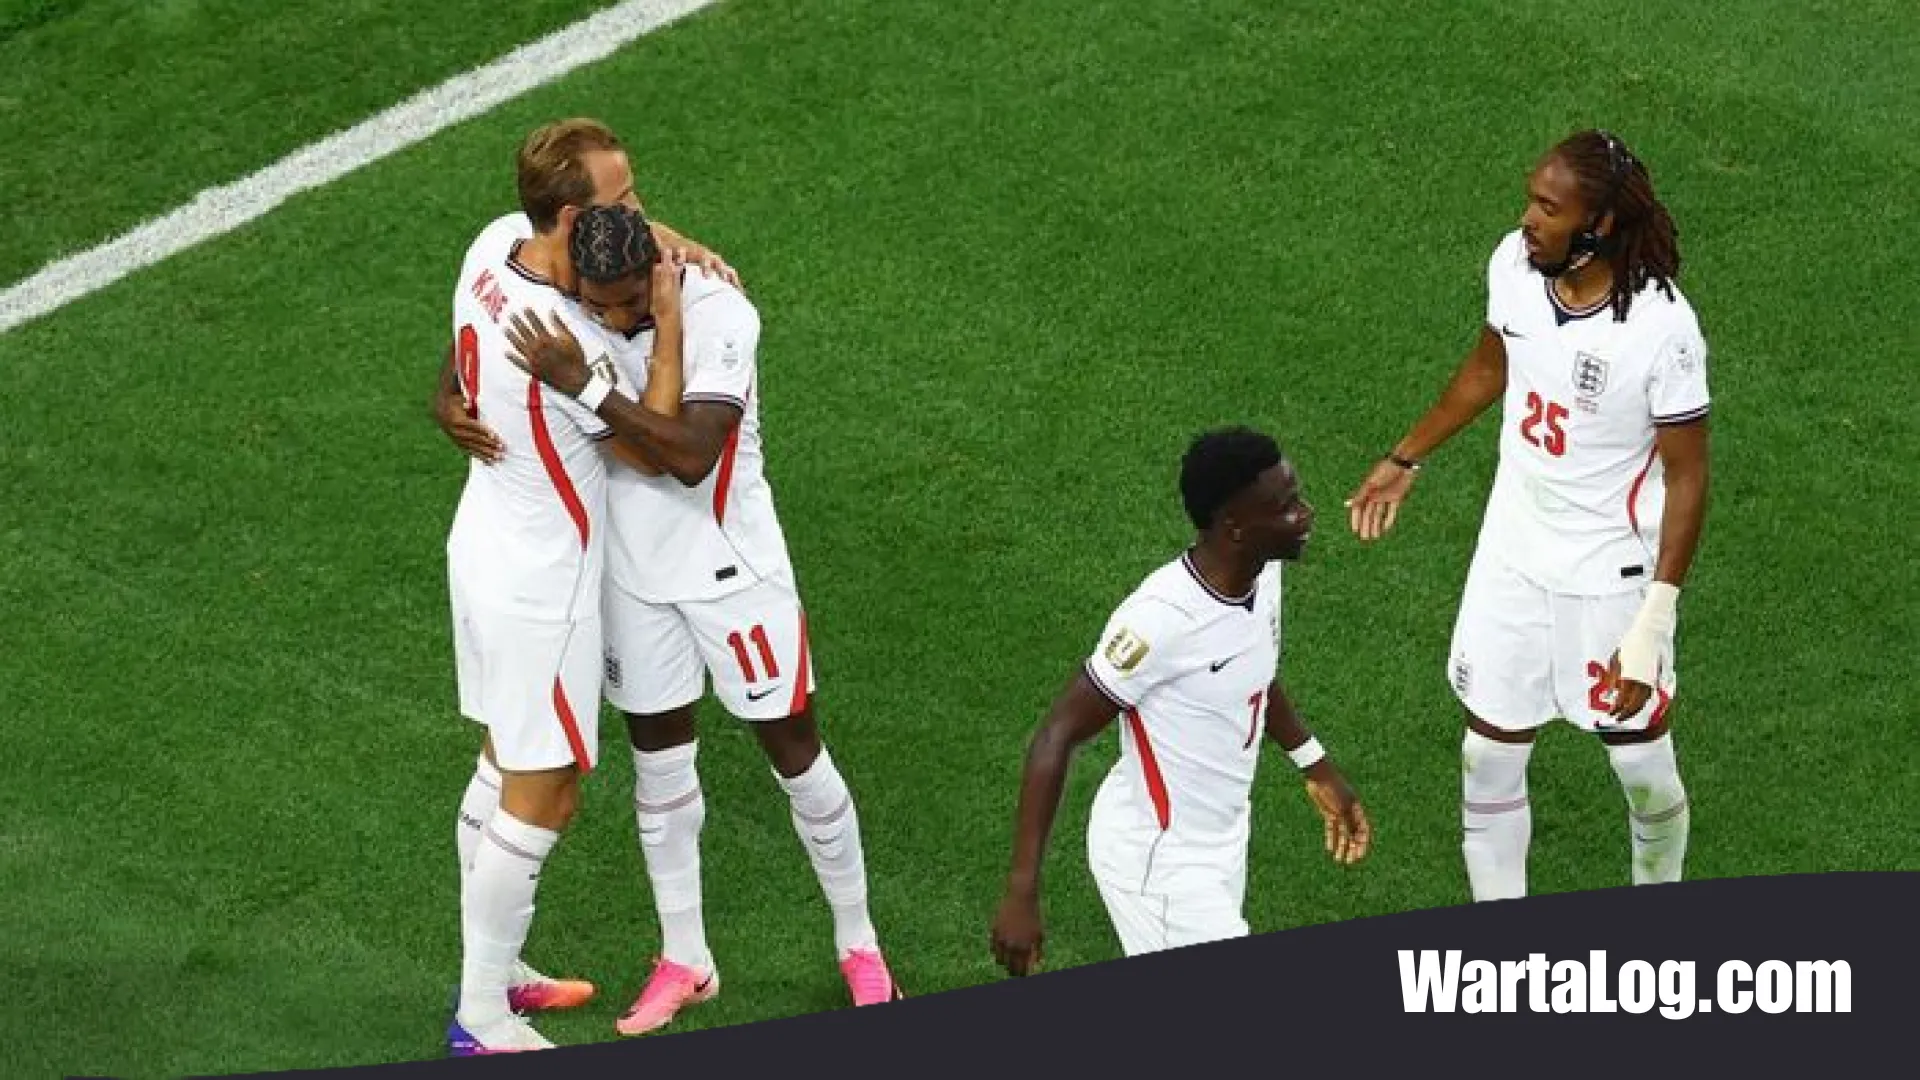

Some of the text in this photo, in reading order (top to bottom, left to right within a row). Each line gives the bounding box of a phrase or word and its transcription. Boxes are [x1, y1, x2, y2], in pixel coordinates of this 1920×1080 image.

[1519, 391, 1570, 458] 25
[727, 623, 780, 683] 11
[1243, 690, 1263, 751] 7
